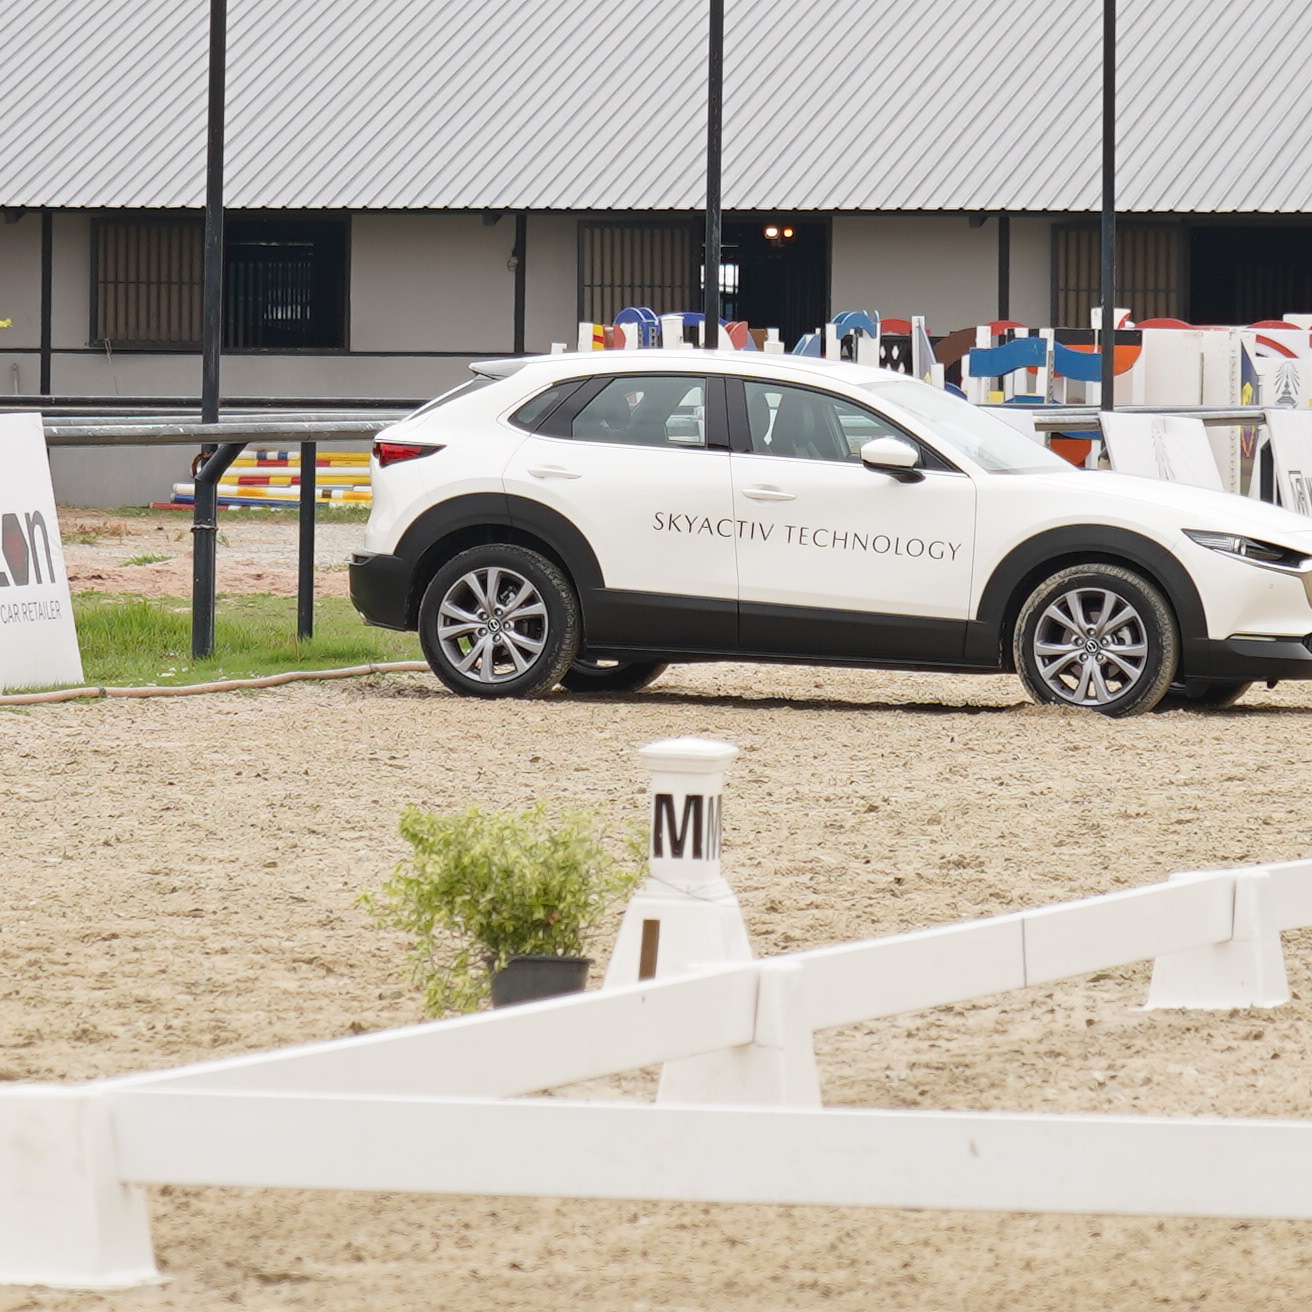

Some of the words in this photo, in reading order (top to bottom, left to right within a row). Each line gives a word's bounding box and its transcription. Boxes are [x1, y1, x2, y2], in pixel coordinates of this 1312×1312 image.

[652, 512, 775, 542] SKYACTIV
[784, 524, 962, 561] TECHNOLOGY
[0, 603, 21, 624] CAR
[22, 600, 62, 623] RETAILER
[654, 794, 703, 859] M
